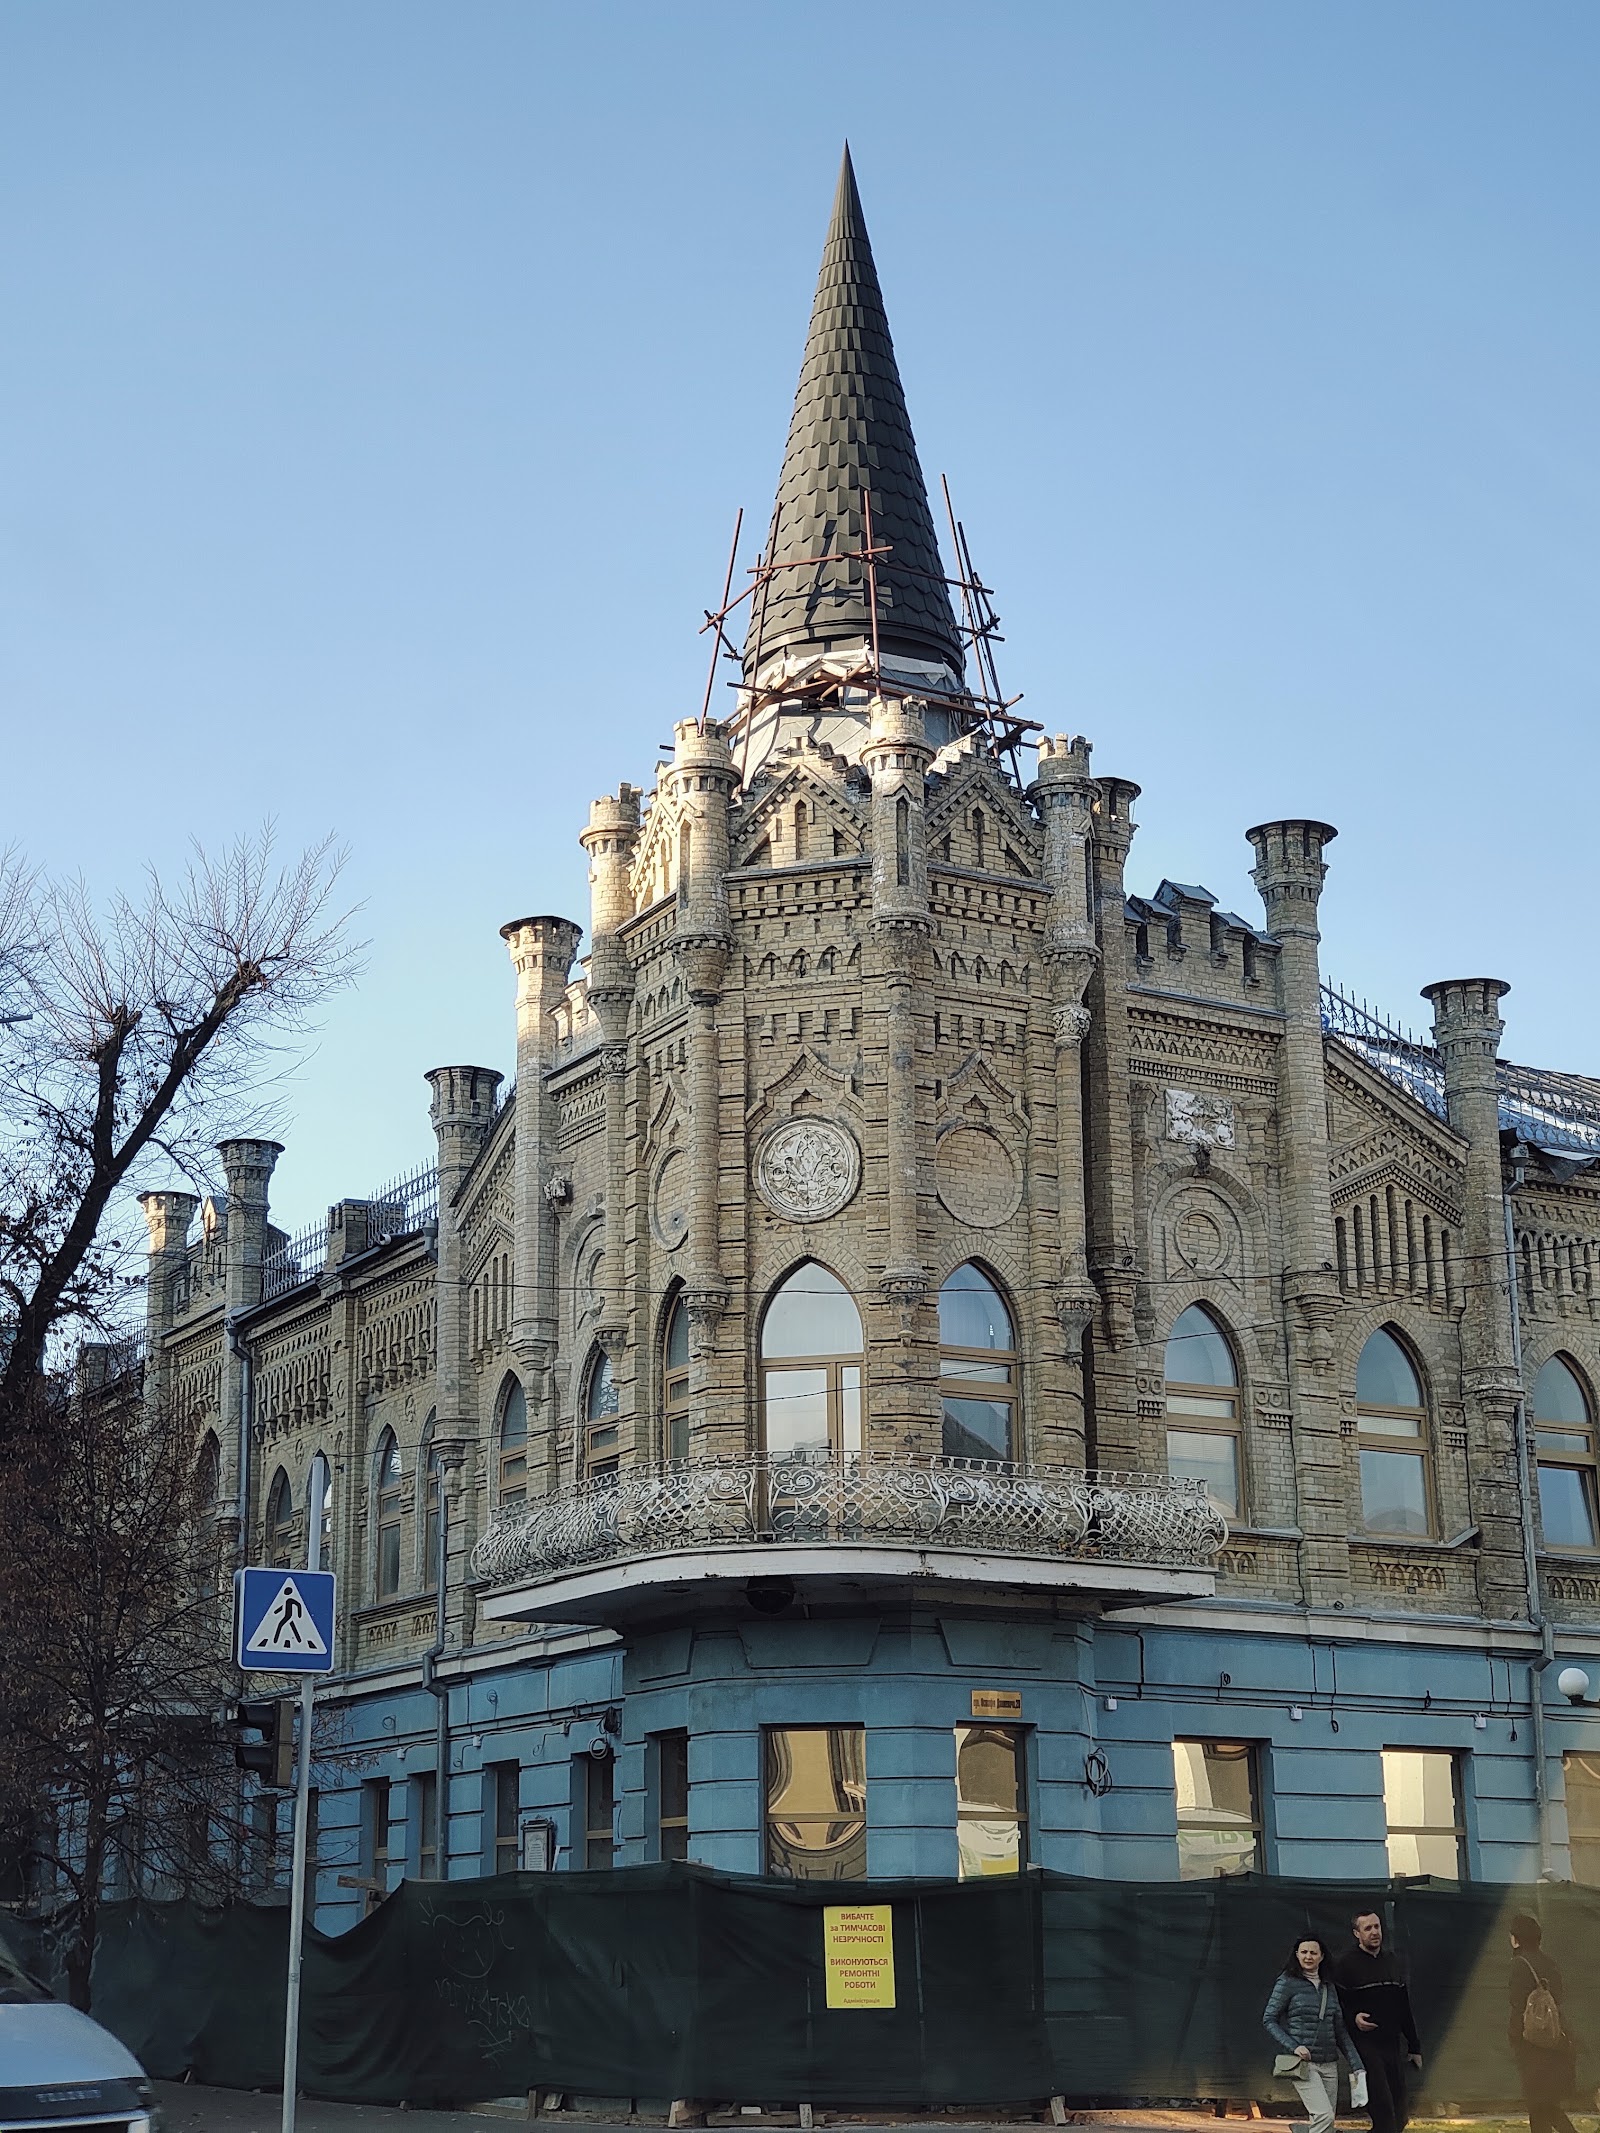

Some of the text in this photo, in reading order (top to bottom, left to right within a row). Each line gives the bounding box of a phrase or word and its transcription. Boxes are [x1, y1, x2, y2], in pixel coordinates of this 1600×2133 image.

[840, 1913, 875, 1921] ВИБАЧТЕ
[840, 1924, 886, 1932] ТИМЧАСОВІ
[833, 1935, 884, 1943] НЕЗРУЧНОСТІ
[830, 1958, 888, 1966] ВИКОНУЮТЬСЯ
[844, 1981, 876, 1989] РОБОТИ
